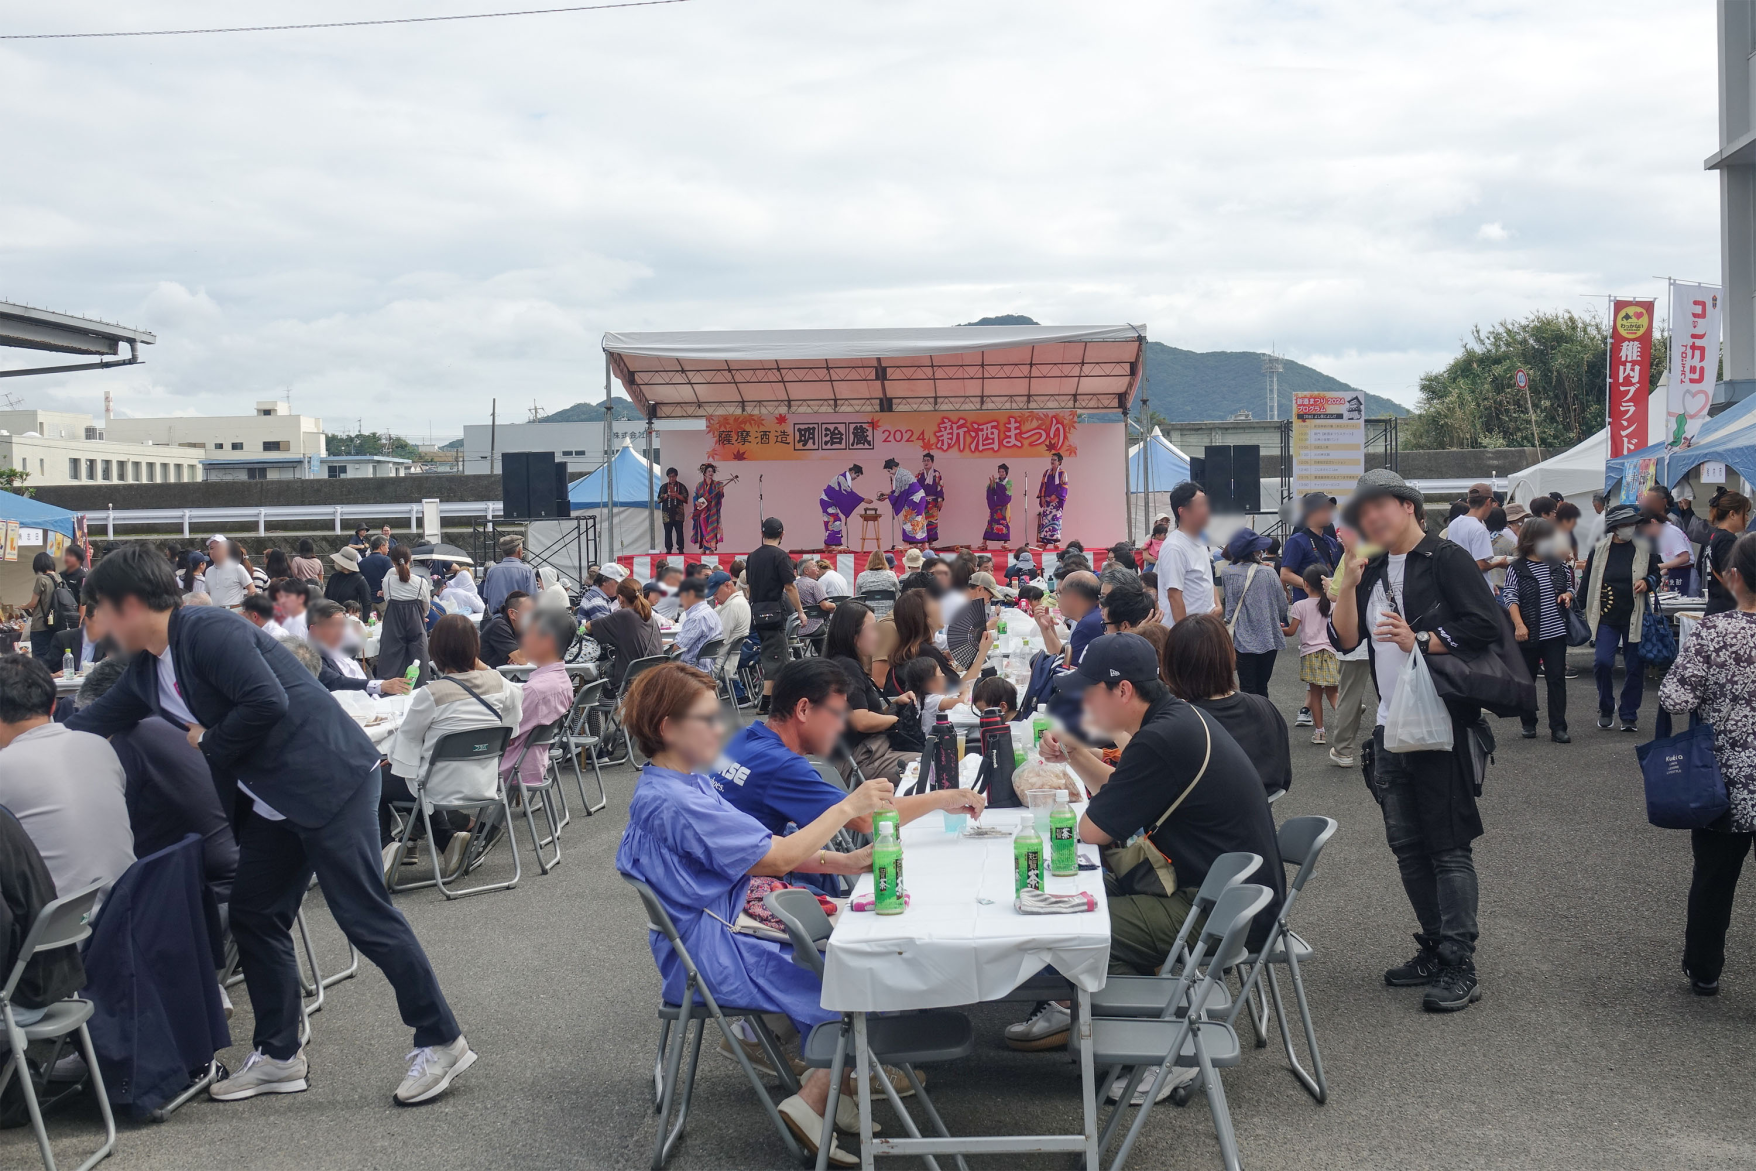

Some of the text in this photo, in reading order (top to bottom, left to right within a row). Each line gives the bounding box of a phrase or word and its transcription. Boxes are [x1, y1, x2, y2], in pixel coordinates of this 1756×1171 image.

[718, 417, 1067, 452] 薩摩酒造 明治蔵 2024 新酒まつり
[1618, 341, 1642, 455] 稚内ブランド
